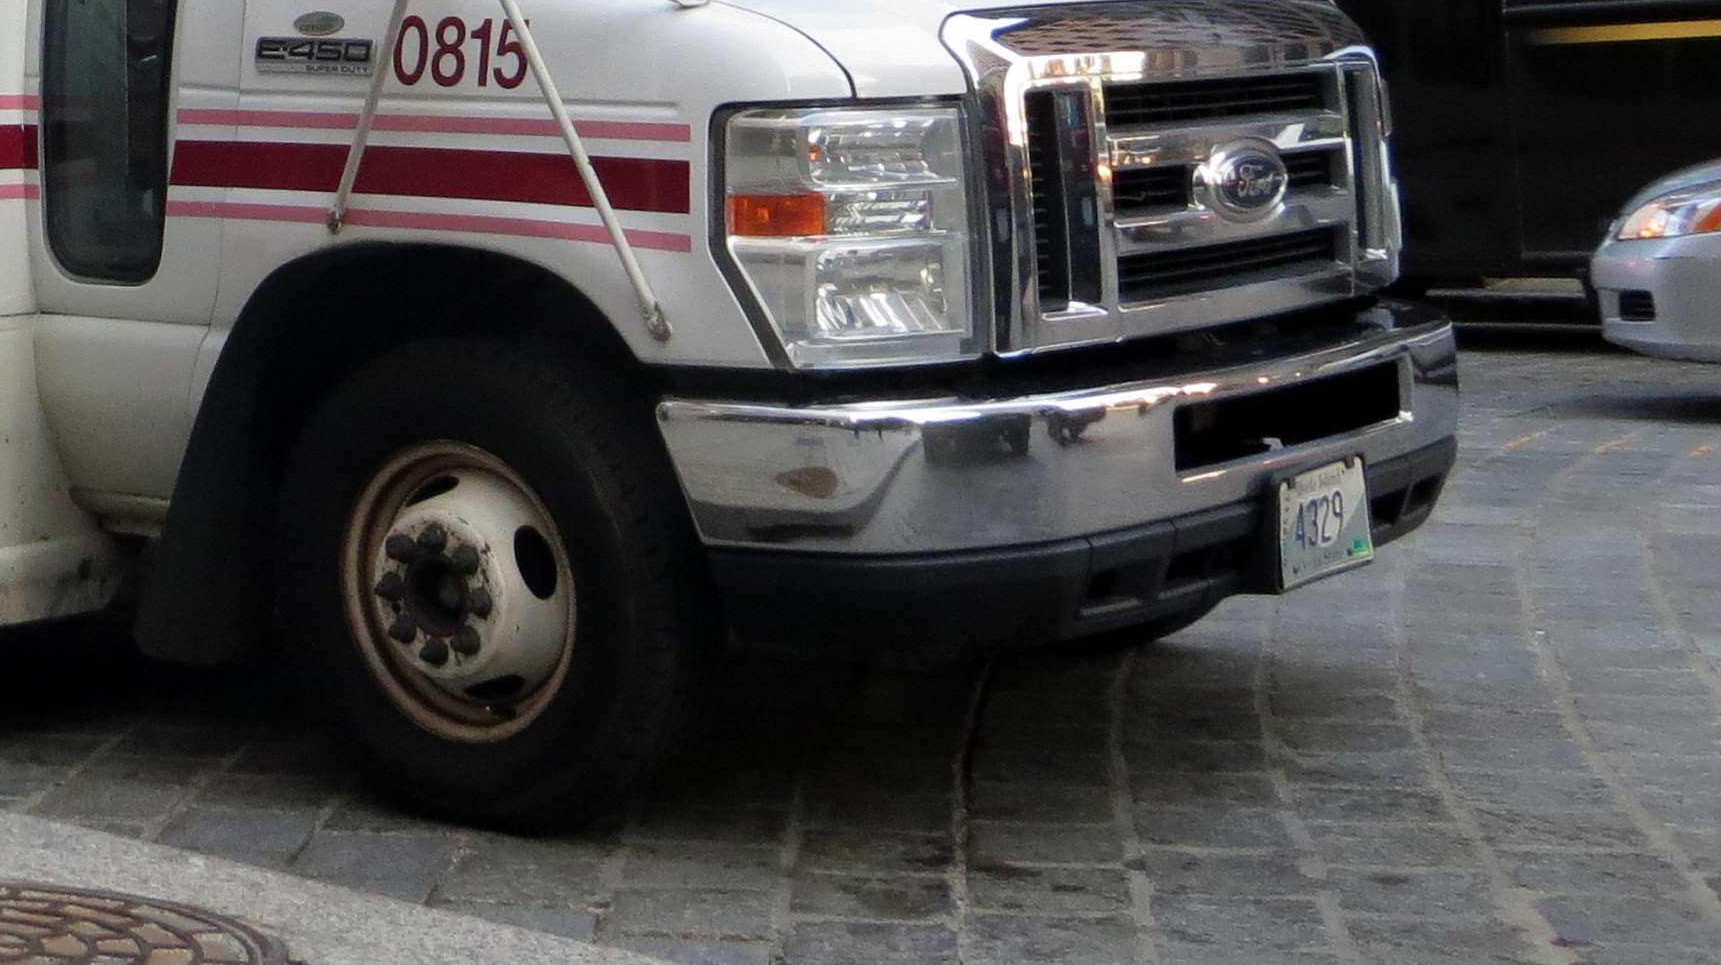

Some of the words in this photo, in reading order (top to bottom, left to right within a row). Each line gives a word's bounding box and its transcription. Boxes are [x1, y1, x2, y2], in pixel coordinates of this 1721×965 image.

[341, 65, 369, 73] DUTY
[393, 15, 530, 89] 0815
[1294, 490, 1343, 550] 4329
